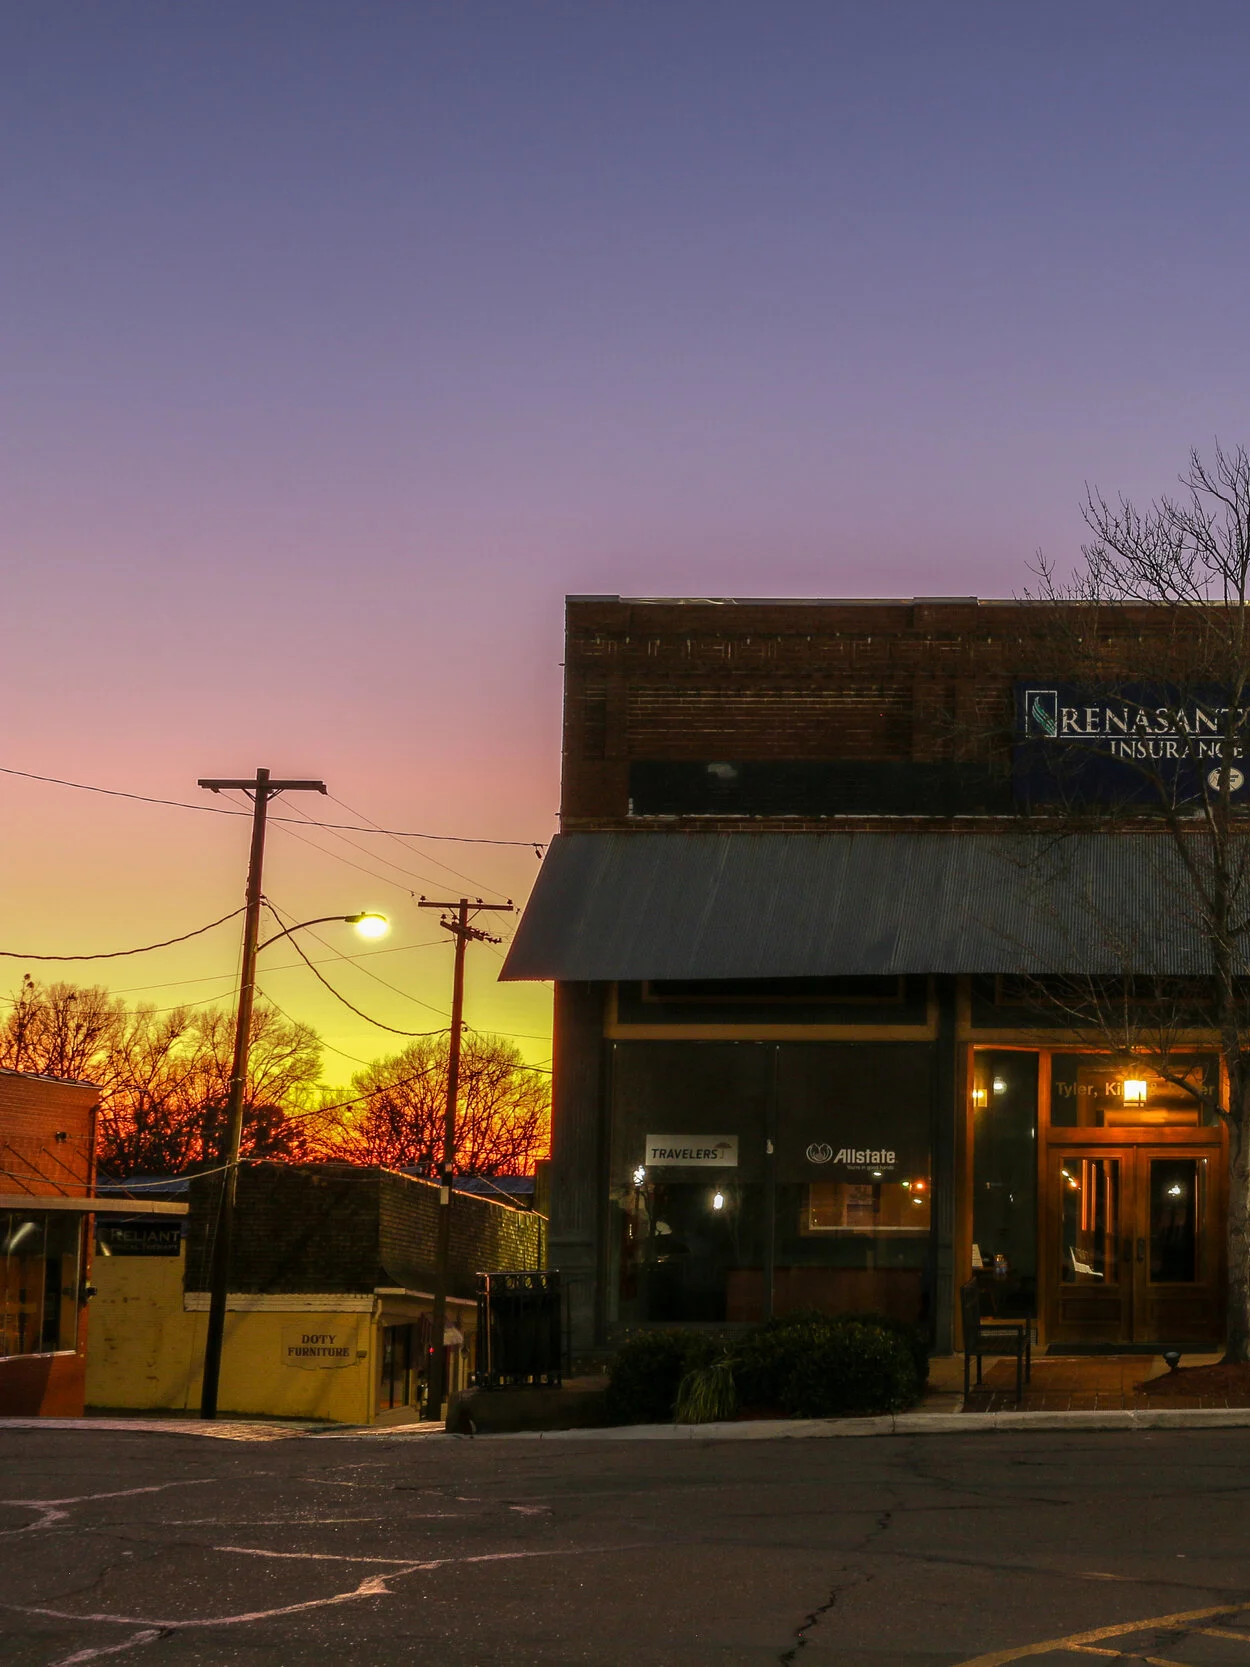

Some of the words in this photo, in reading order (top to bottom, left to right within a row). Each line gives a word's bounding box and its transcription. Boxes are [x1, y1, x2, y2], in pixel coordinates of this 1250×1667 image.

[1056, 1081, 1098, 1098] Tyler,
[651, 1148, 718, 1160] TRAVELERS
[833, 1149, 896, 1164] Allstate
[301, 1334, 337, 1345] DOTY
[287, 1346, 350, 1357] FURNITURE
